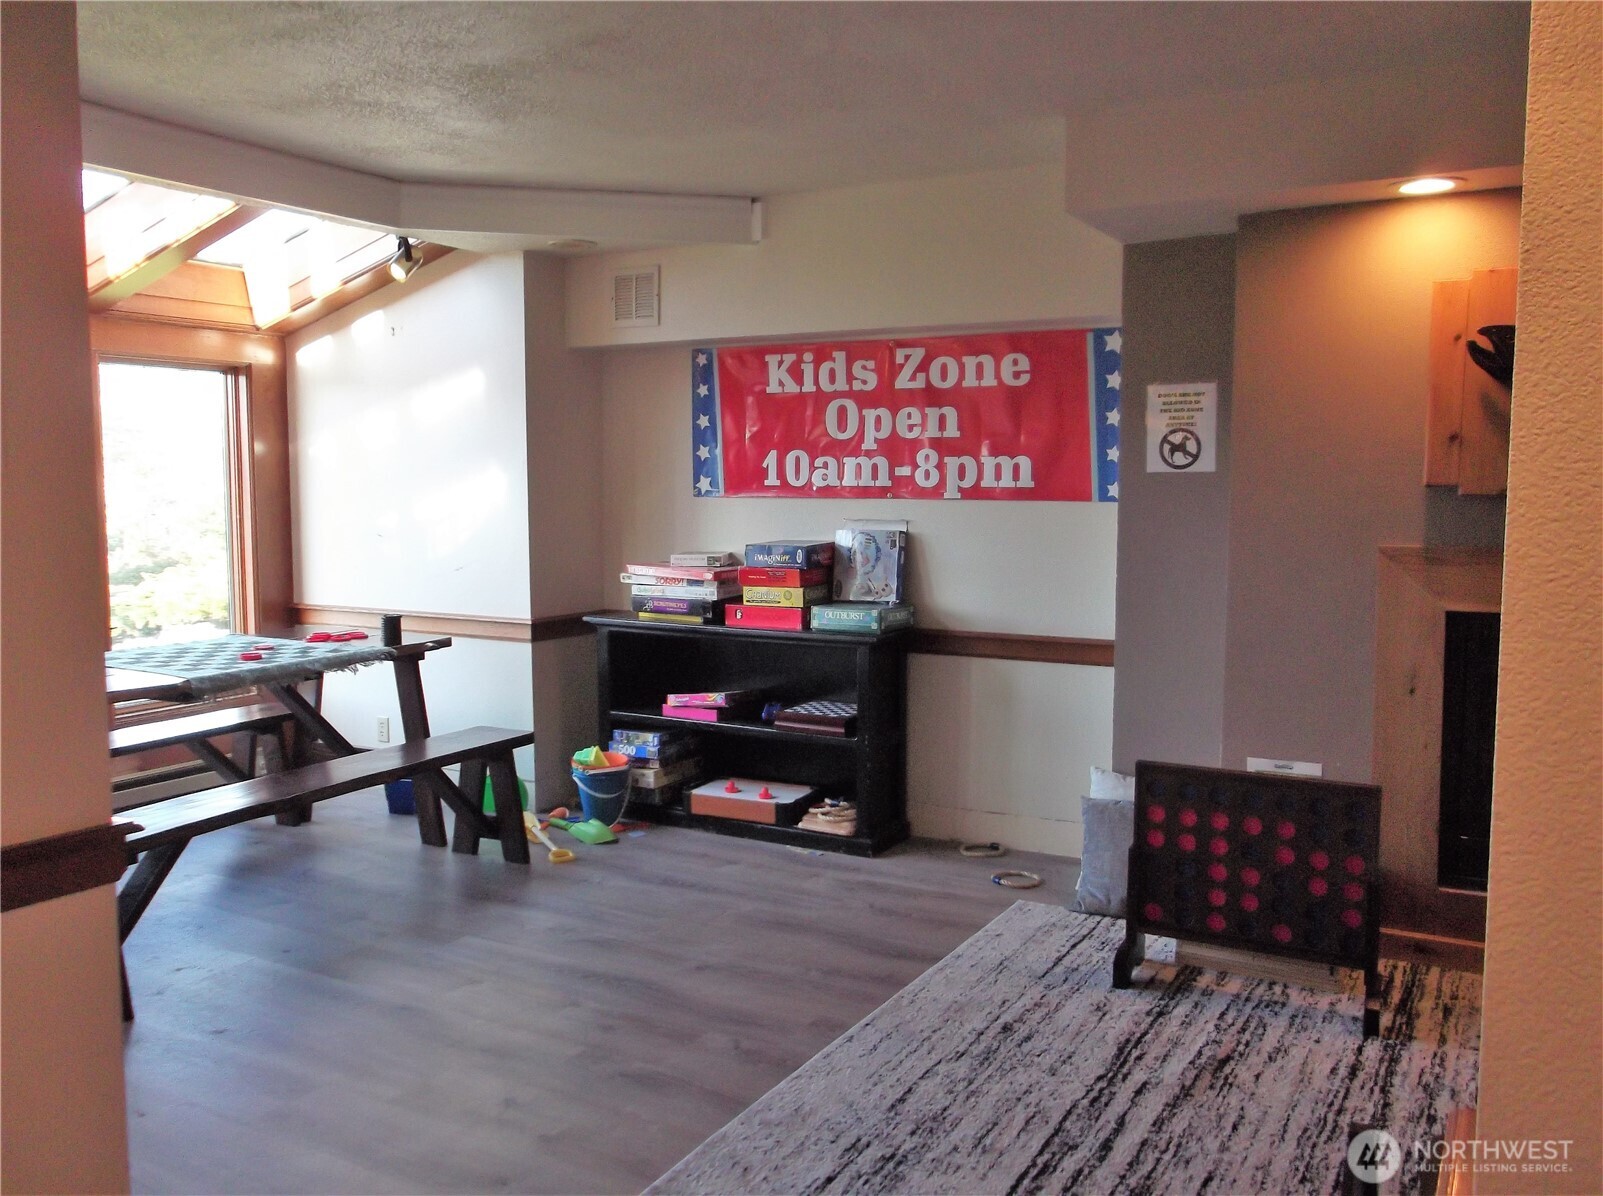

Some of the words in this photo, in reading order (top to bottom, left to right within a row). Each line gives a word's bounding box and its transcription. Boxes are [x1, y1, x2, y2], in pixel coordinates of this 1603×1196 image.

[765, 351, 878, 393] Kids
[895, 347, 1031, 389] Zone
[825, 398, 960, 449] Open
[762, 448, 1035, 499] 10am-8pm
[655, 576, 684, 586] SORRY!
[824, 610, 865, 620] OUTBURST
[618, 744, 636, 756] 500
